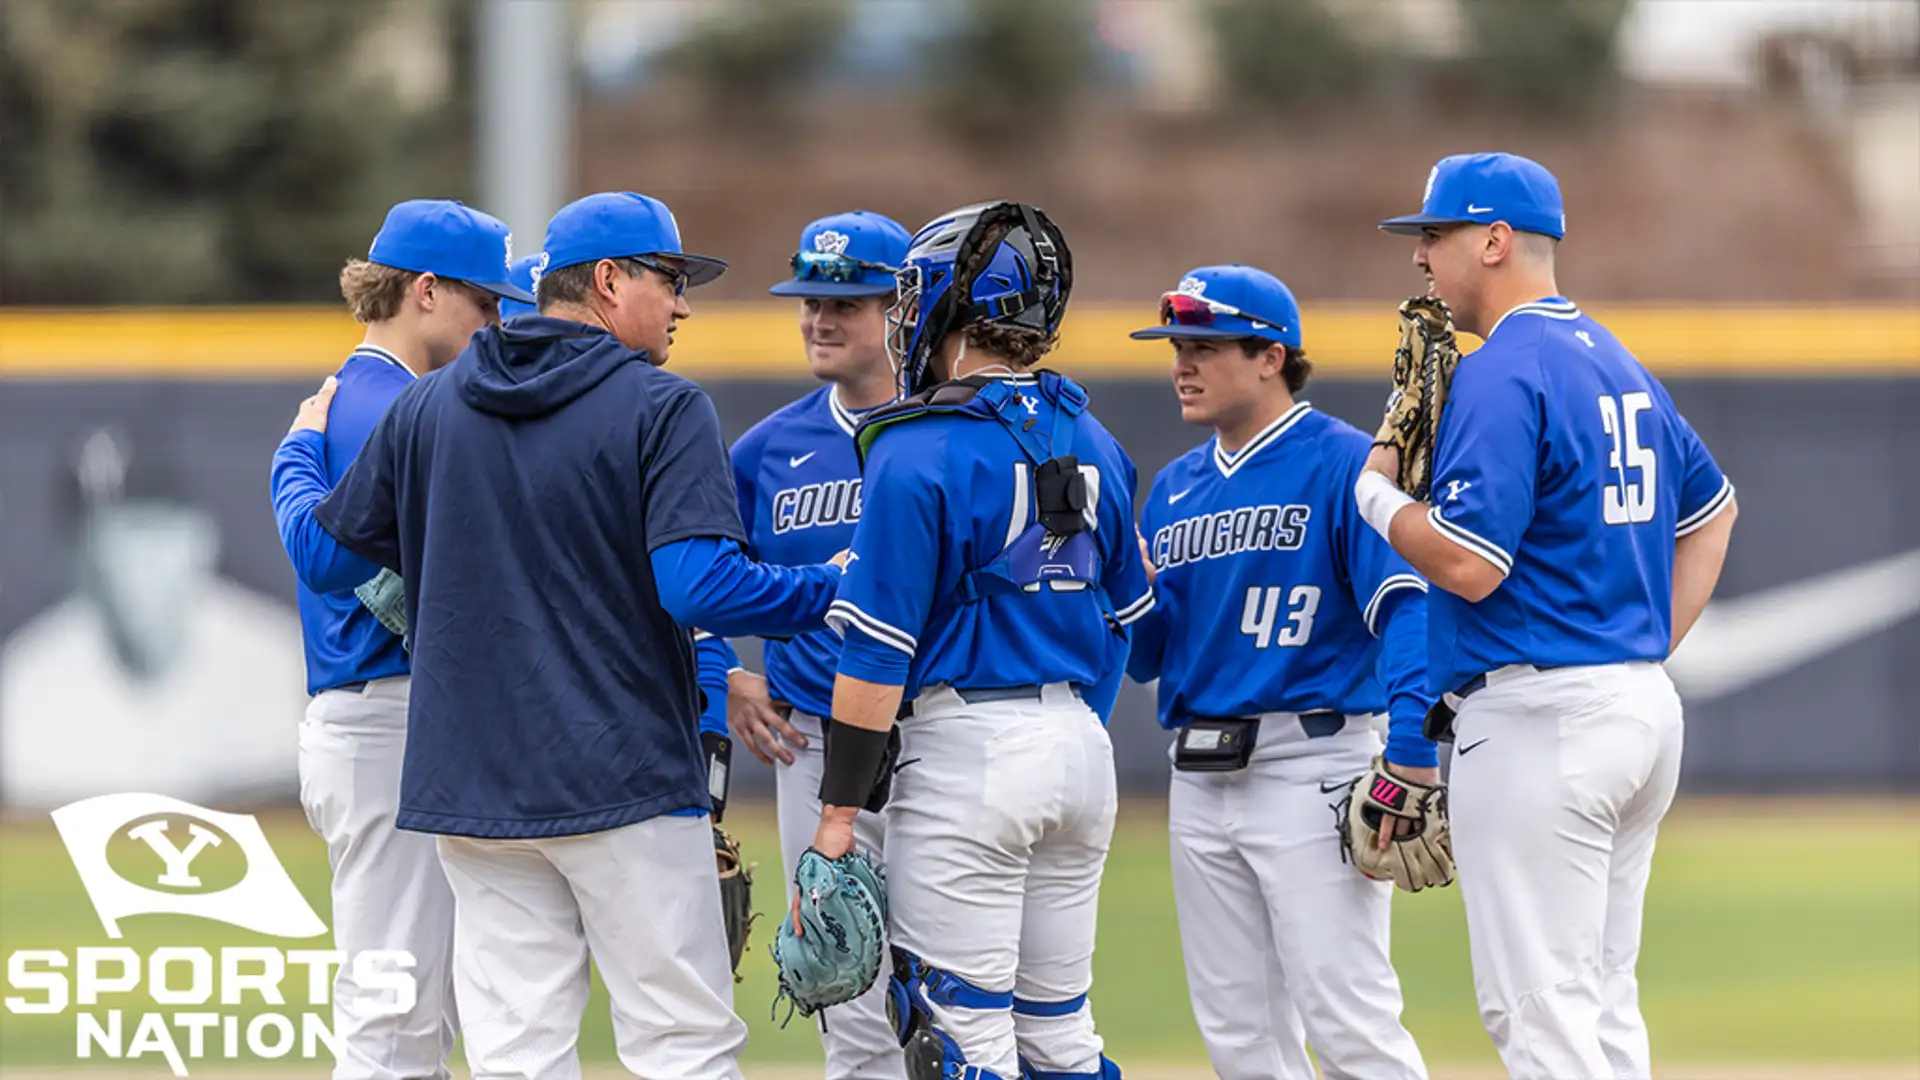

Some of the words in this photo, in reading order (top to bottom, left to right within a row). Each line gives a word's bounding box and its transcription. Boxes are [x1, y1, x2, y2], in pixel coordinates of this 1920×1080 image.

[1022, 395, 1039, 415] Y
[1598, 391, 1656, 525] 35
[1153, 504, 1311, 573] COUGARS
[1240, 584, 1322, 649] 43
